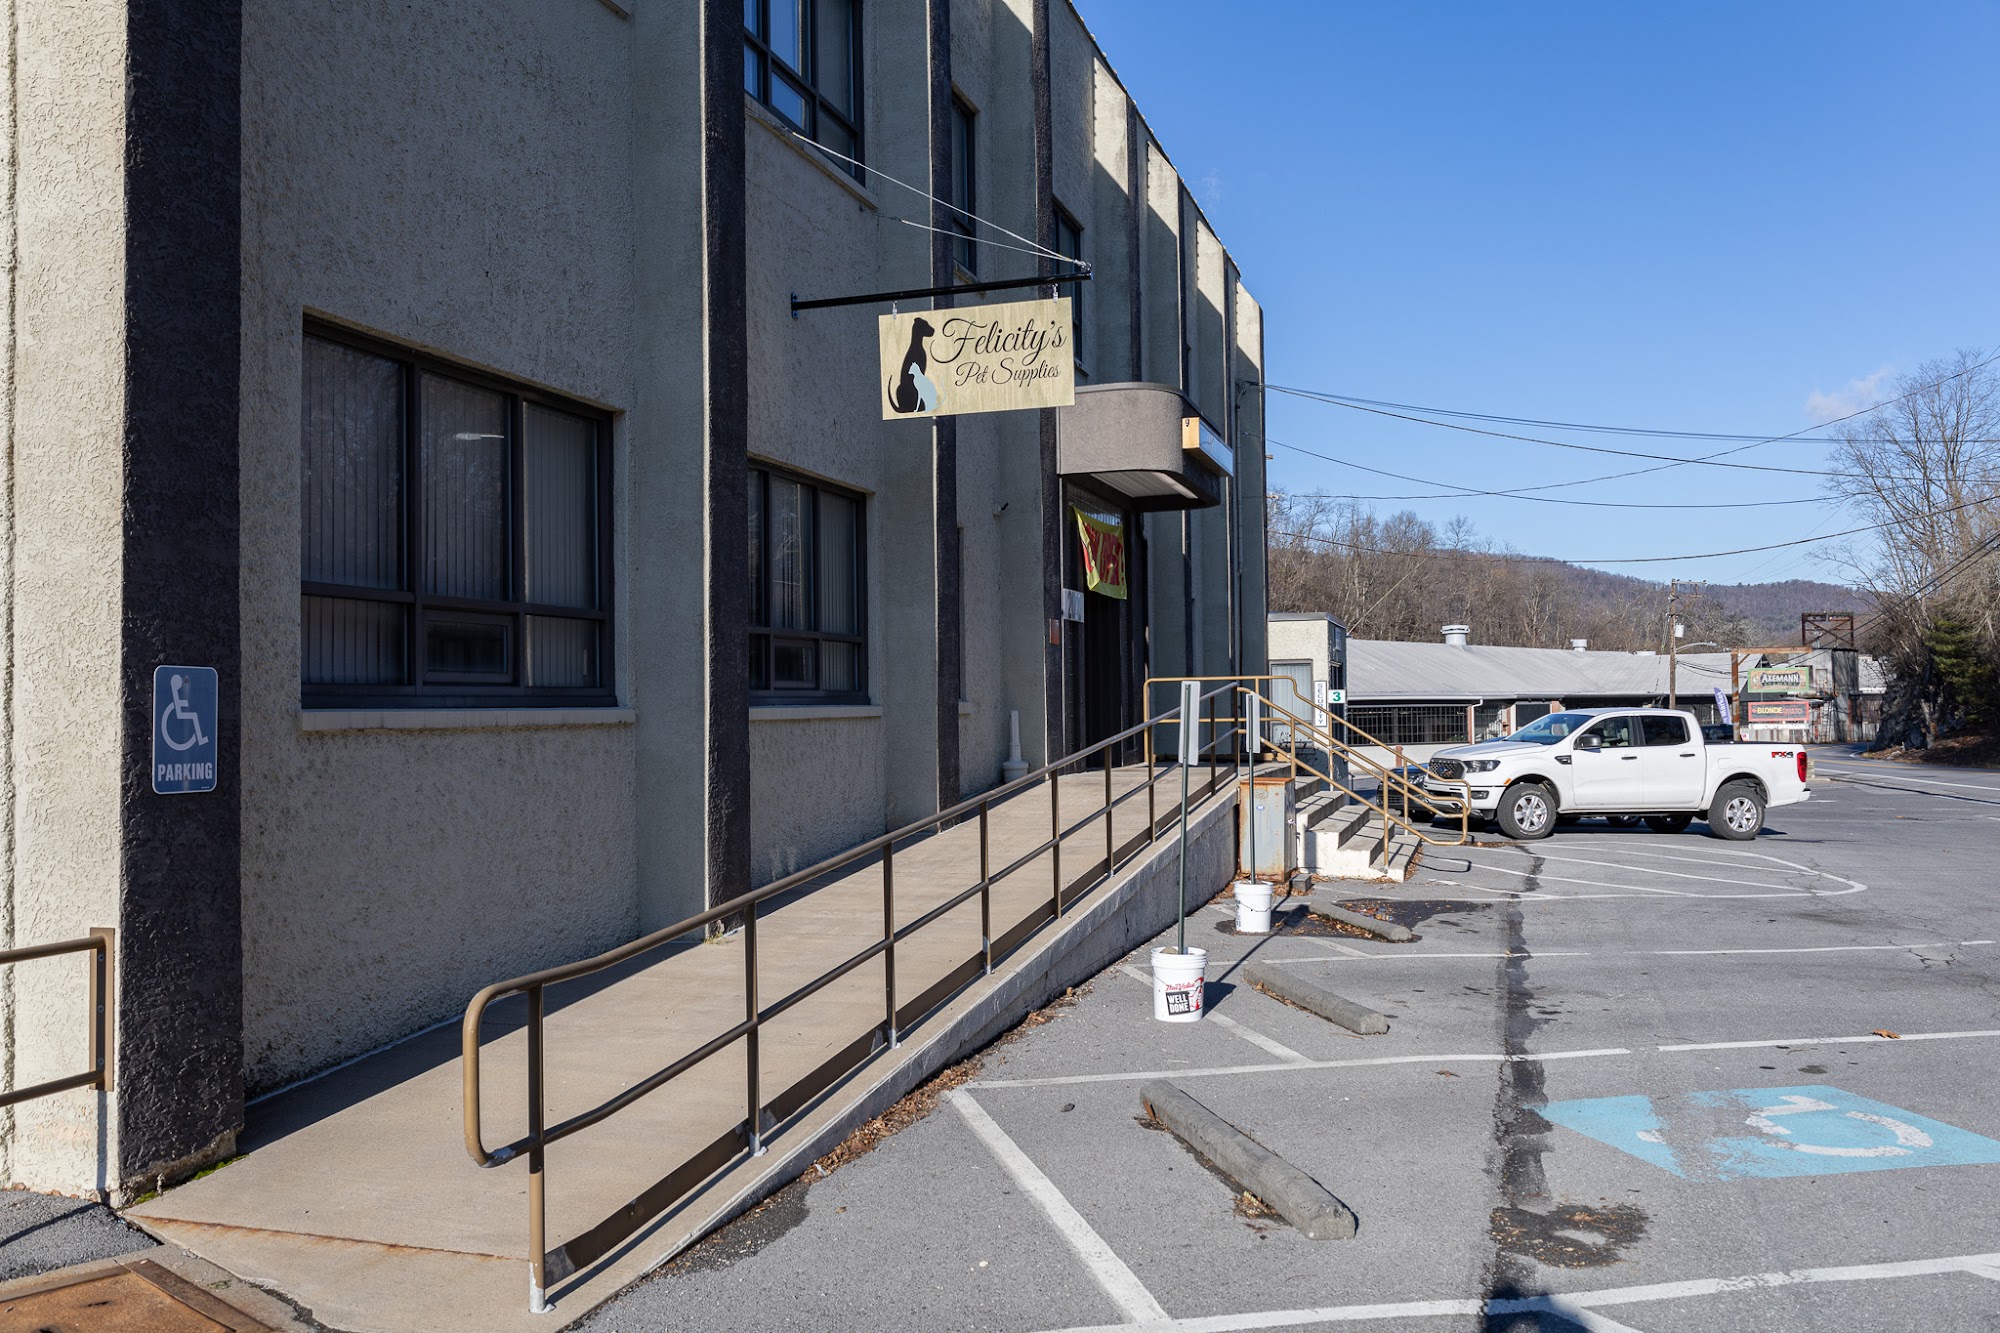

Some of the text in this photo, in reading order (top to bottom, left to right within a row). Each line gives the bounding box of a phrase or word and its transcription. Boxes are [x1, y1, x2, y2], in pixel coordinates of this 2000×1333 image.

[930, 318, 1067, 367] Felicity's
[954, 357, 1061, 387] Pet Supplies
[1761, 673, 1799, 683] AXEMANN
[1332, 691, 1341, 702] 3
[157, 762, 213, 781] PARKING
[1167, 994, 1188, 1004] WELL
[1169, 1003, 1189, 1013] DONE
